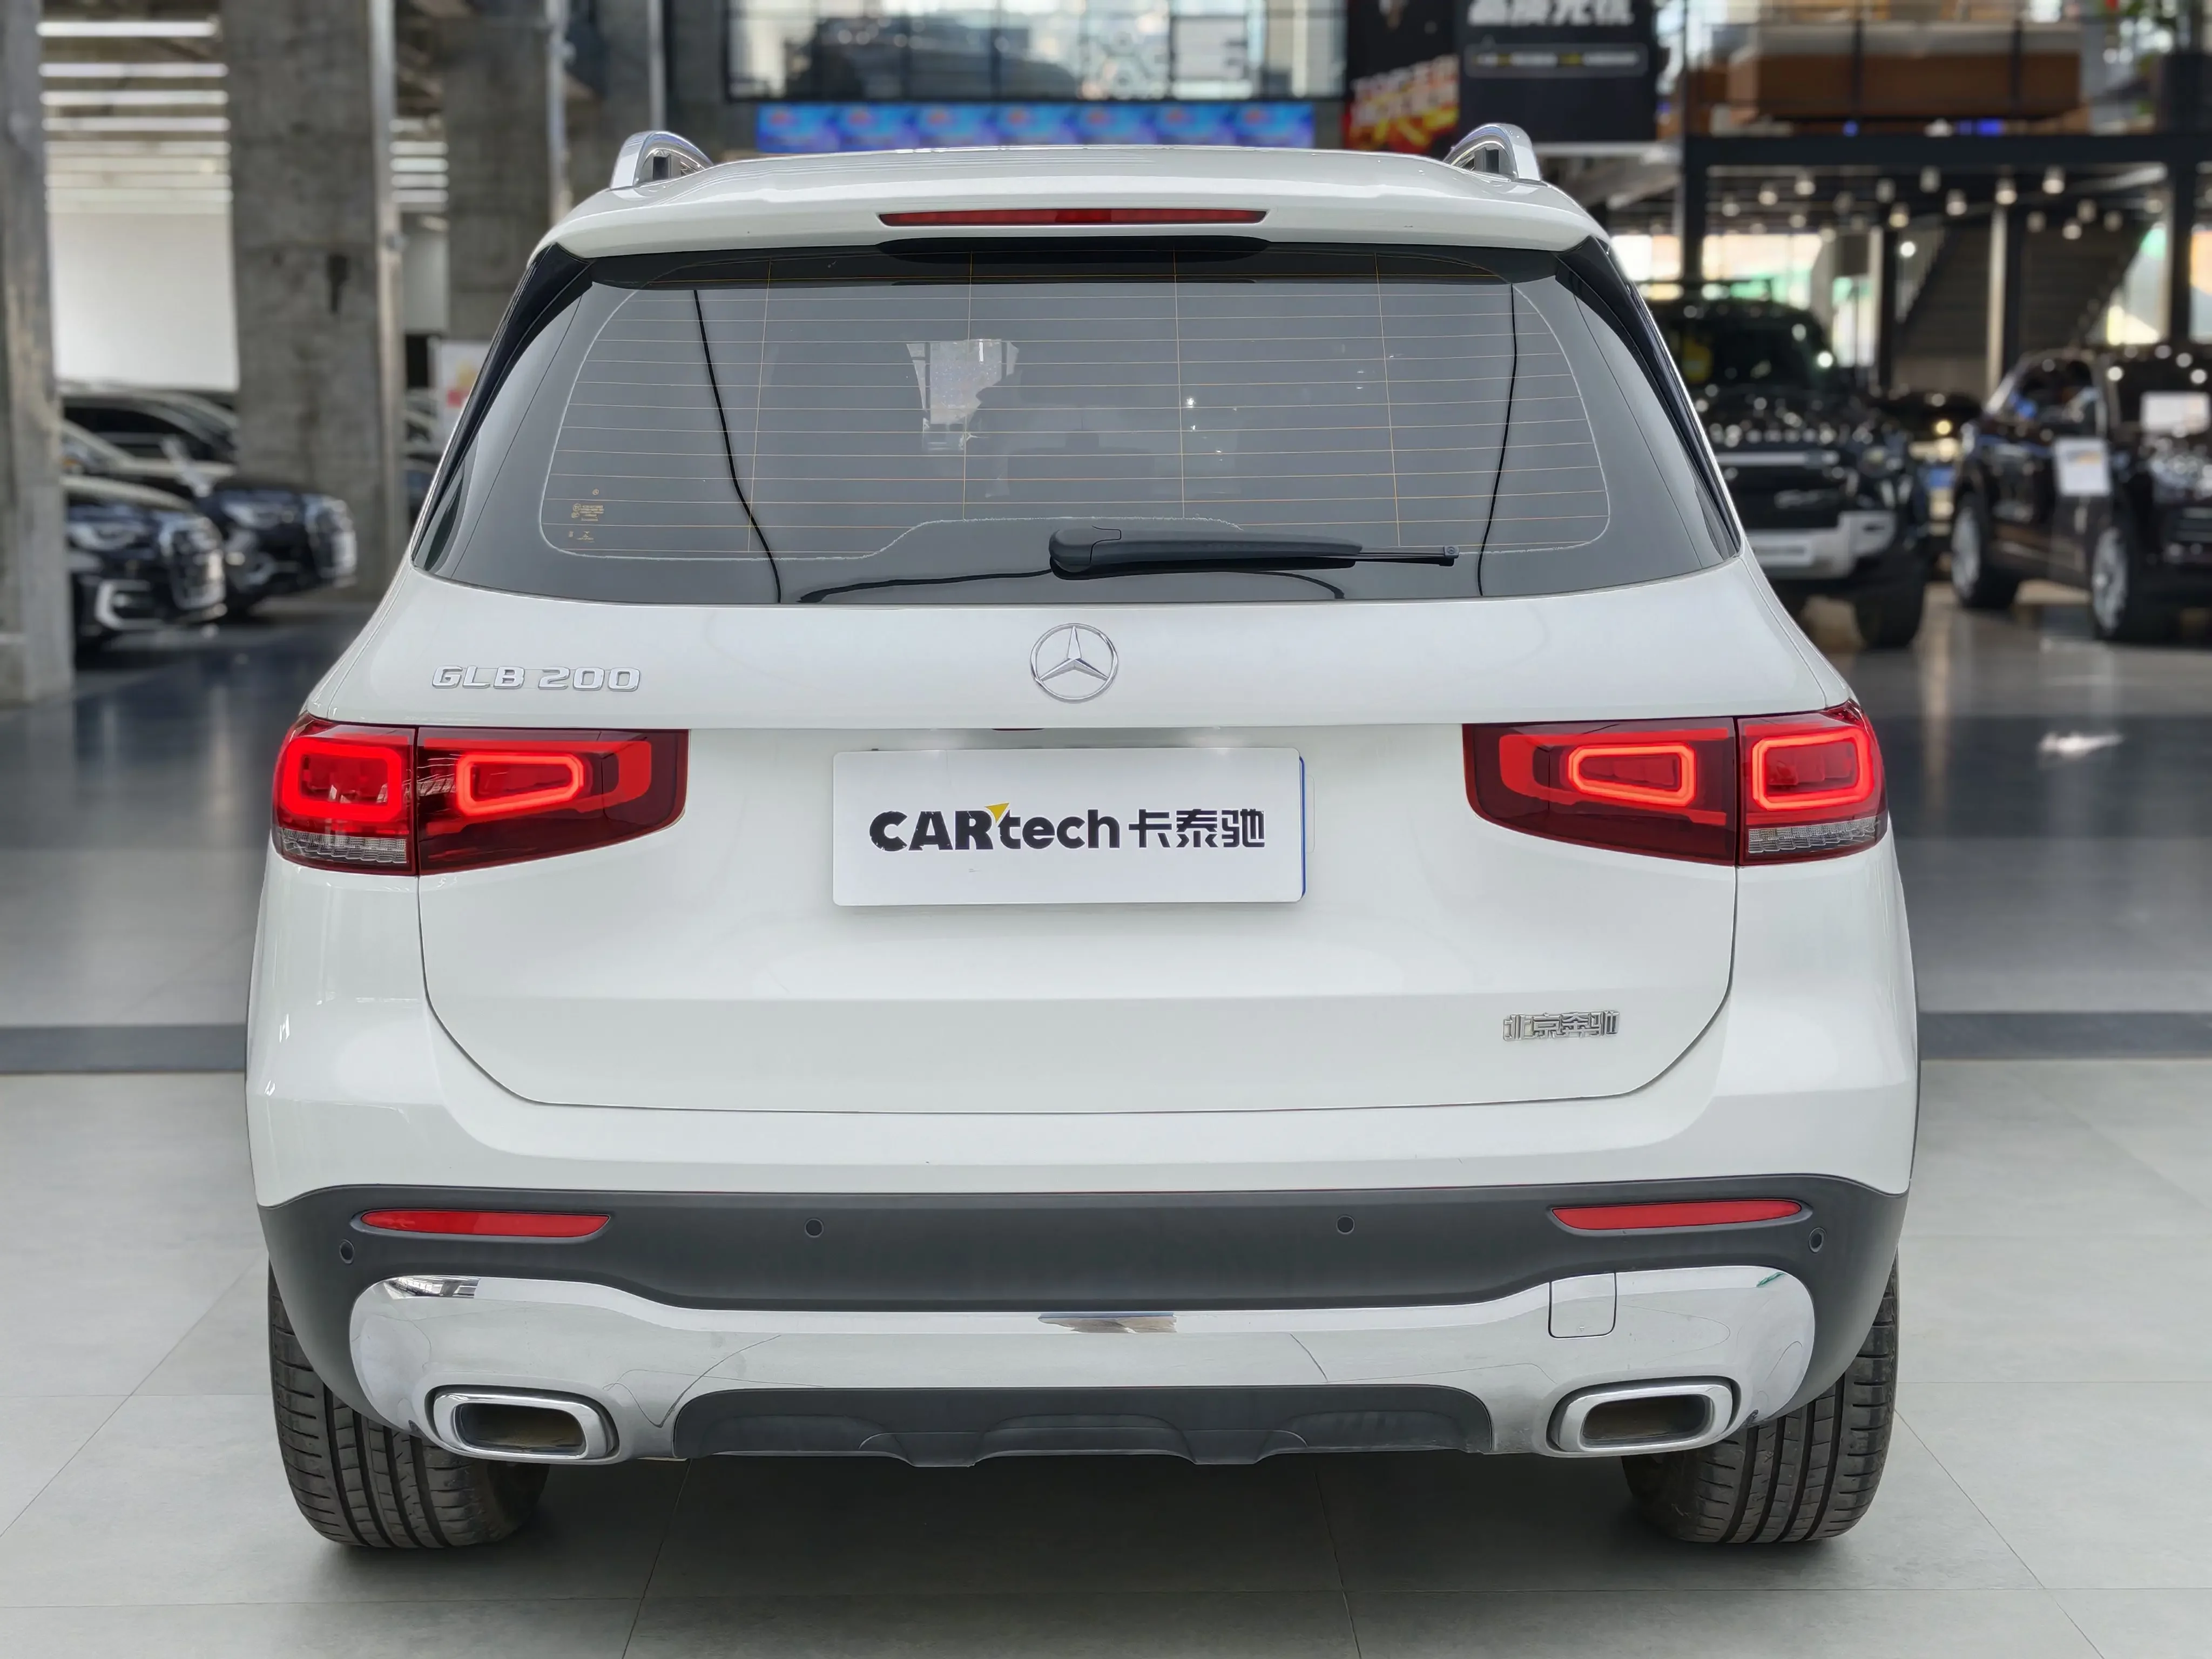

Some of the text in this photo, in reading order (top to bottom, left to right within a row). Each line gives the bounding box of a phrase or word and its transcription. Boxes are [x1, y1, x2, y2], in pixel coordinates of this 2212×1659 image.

[432, 665, 641, 692] GLB 200
[869, 807, 1265, 852] CARtech 卡泰驰
[1503, 1009, 1620, 1041] 北京奔驰
